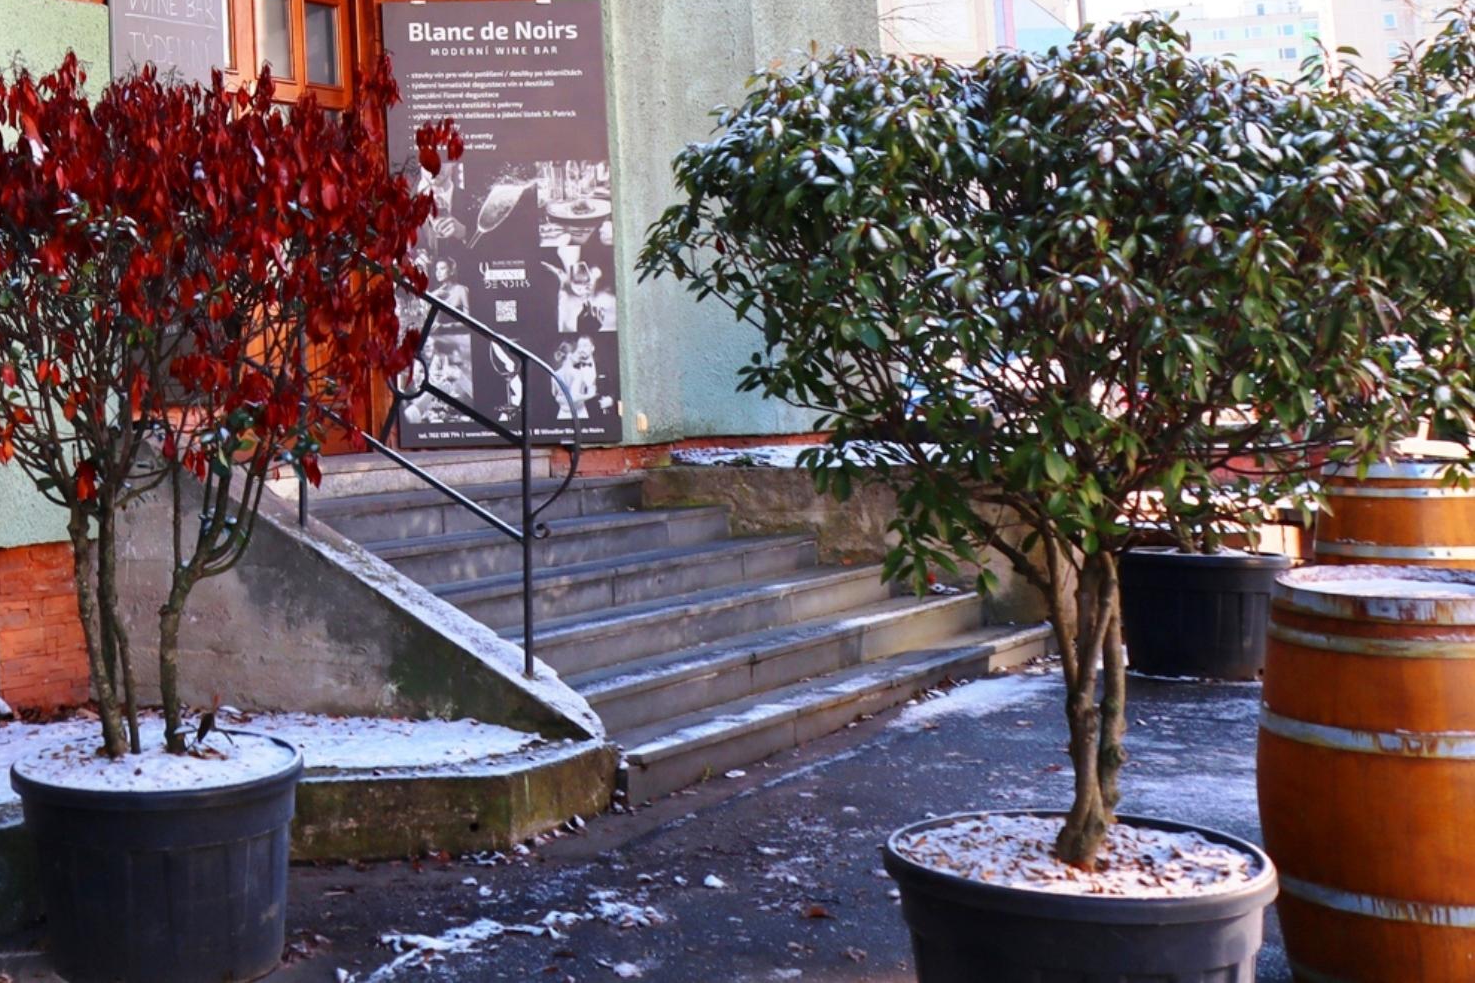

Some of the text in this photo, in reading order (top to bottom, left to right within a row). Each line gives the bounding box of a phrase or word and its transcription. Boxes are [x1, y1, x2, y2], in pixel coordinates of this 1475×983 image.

[408, 20, 578, 42] Blanc de Noirs
[430, 45, 558, 57] MODERNÍ WINE BAR
